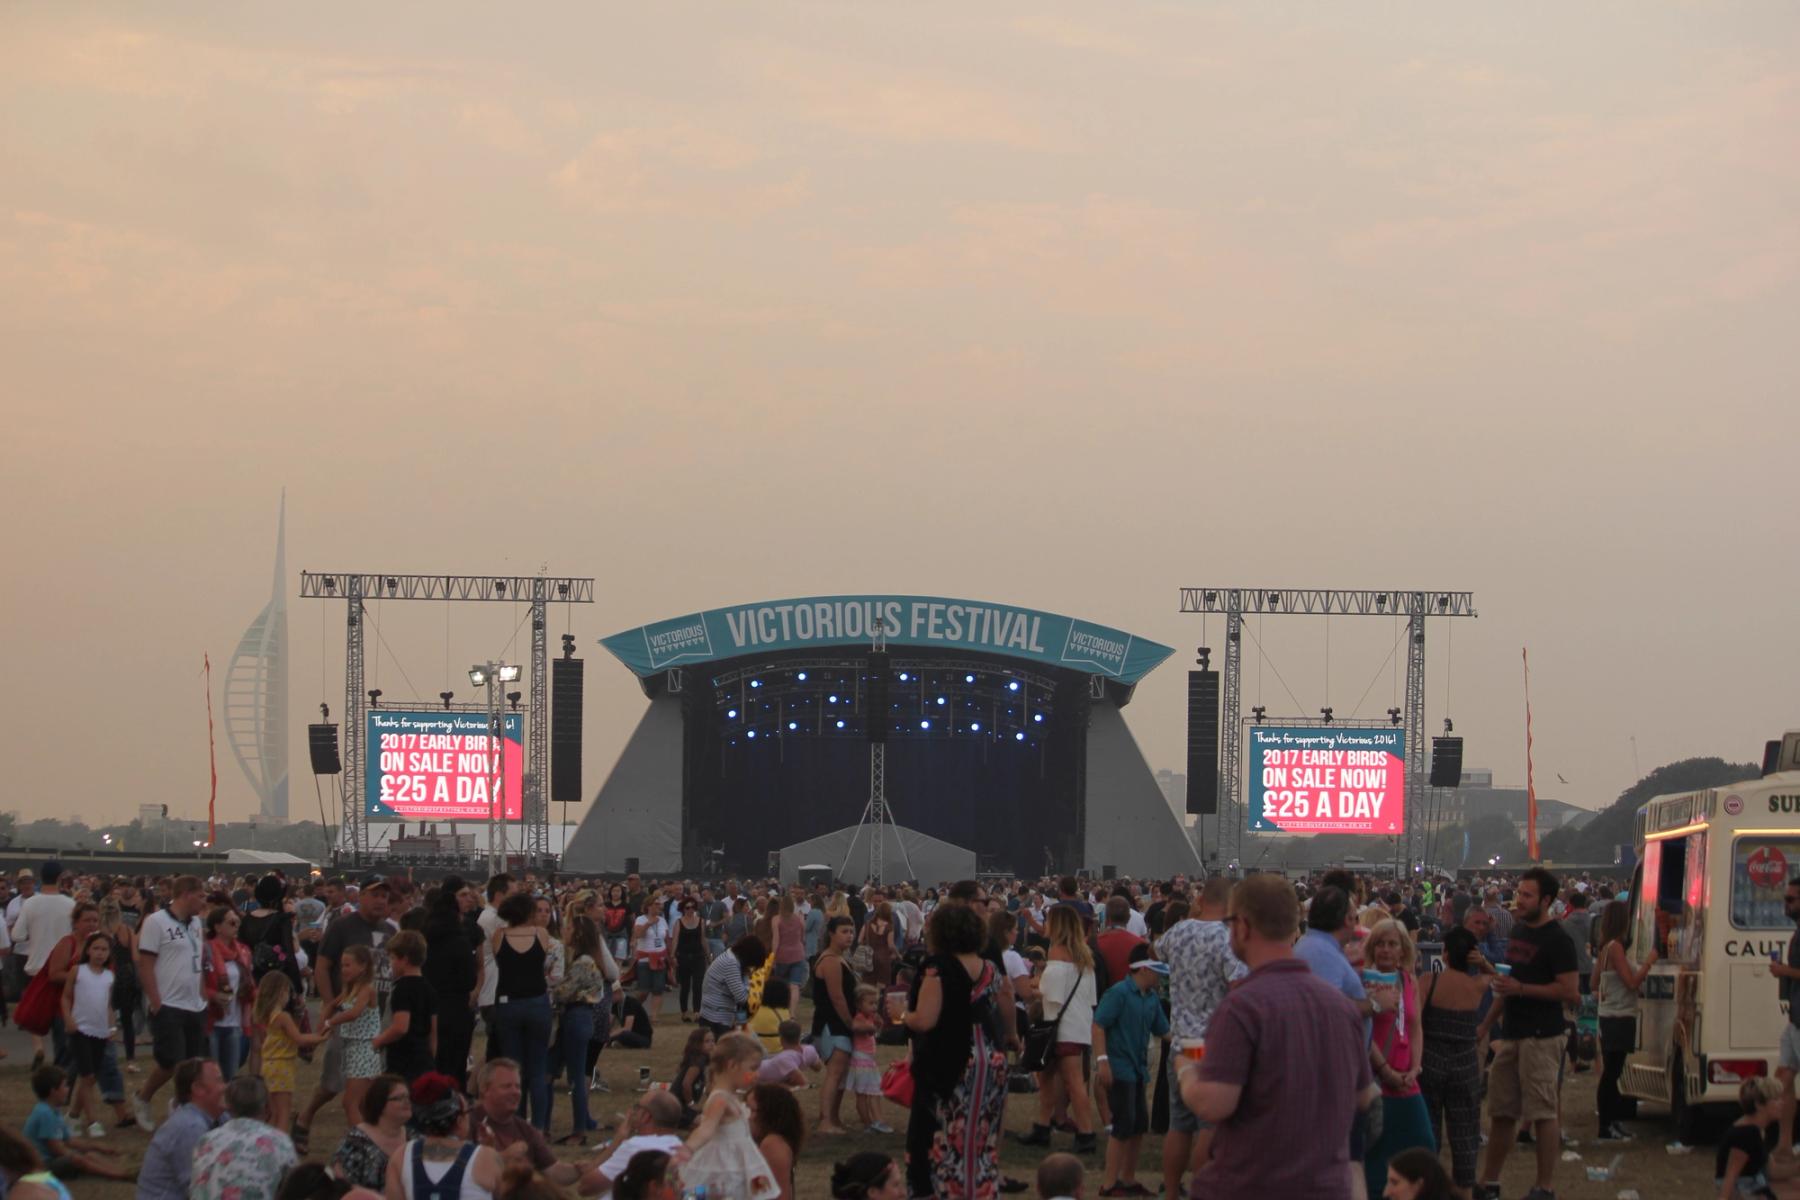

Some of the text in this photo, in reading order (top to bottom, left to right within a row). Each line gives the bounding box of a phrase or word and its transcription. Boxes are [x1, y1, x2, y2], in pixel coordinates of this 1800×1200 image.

[650, 625, 704, 647] VICTORIOUS
[726, 601, 1044, 653] VICTORIOUS FESTIVAL
[1072, 630, 1125, 656] VICTORIOUS
[372, 716, 399, 728] Thanks
[401, 717, 412, 728] for
[413, 720, 453, 733] supporting
[380, 733, 416, 749] 2017
[419, 734, 464, 750] EARLY
[1254, 731, 1397, 748] Thanks for supporting Victorious 2016!
[380, 751, 501, 774] ON SALE NOW
[1263, 749, 1388, 766] 2017 EARLY BIRDS
[380, 774, 502, 803] £25 A DAY
[1263, 767, 1387, 789] ON SALE NOW!
[1263, 790, 1385, 818] £25 A DAY
